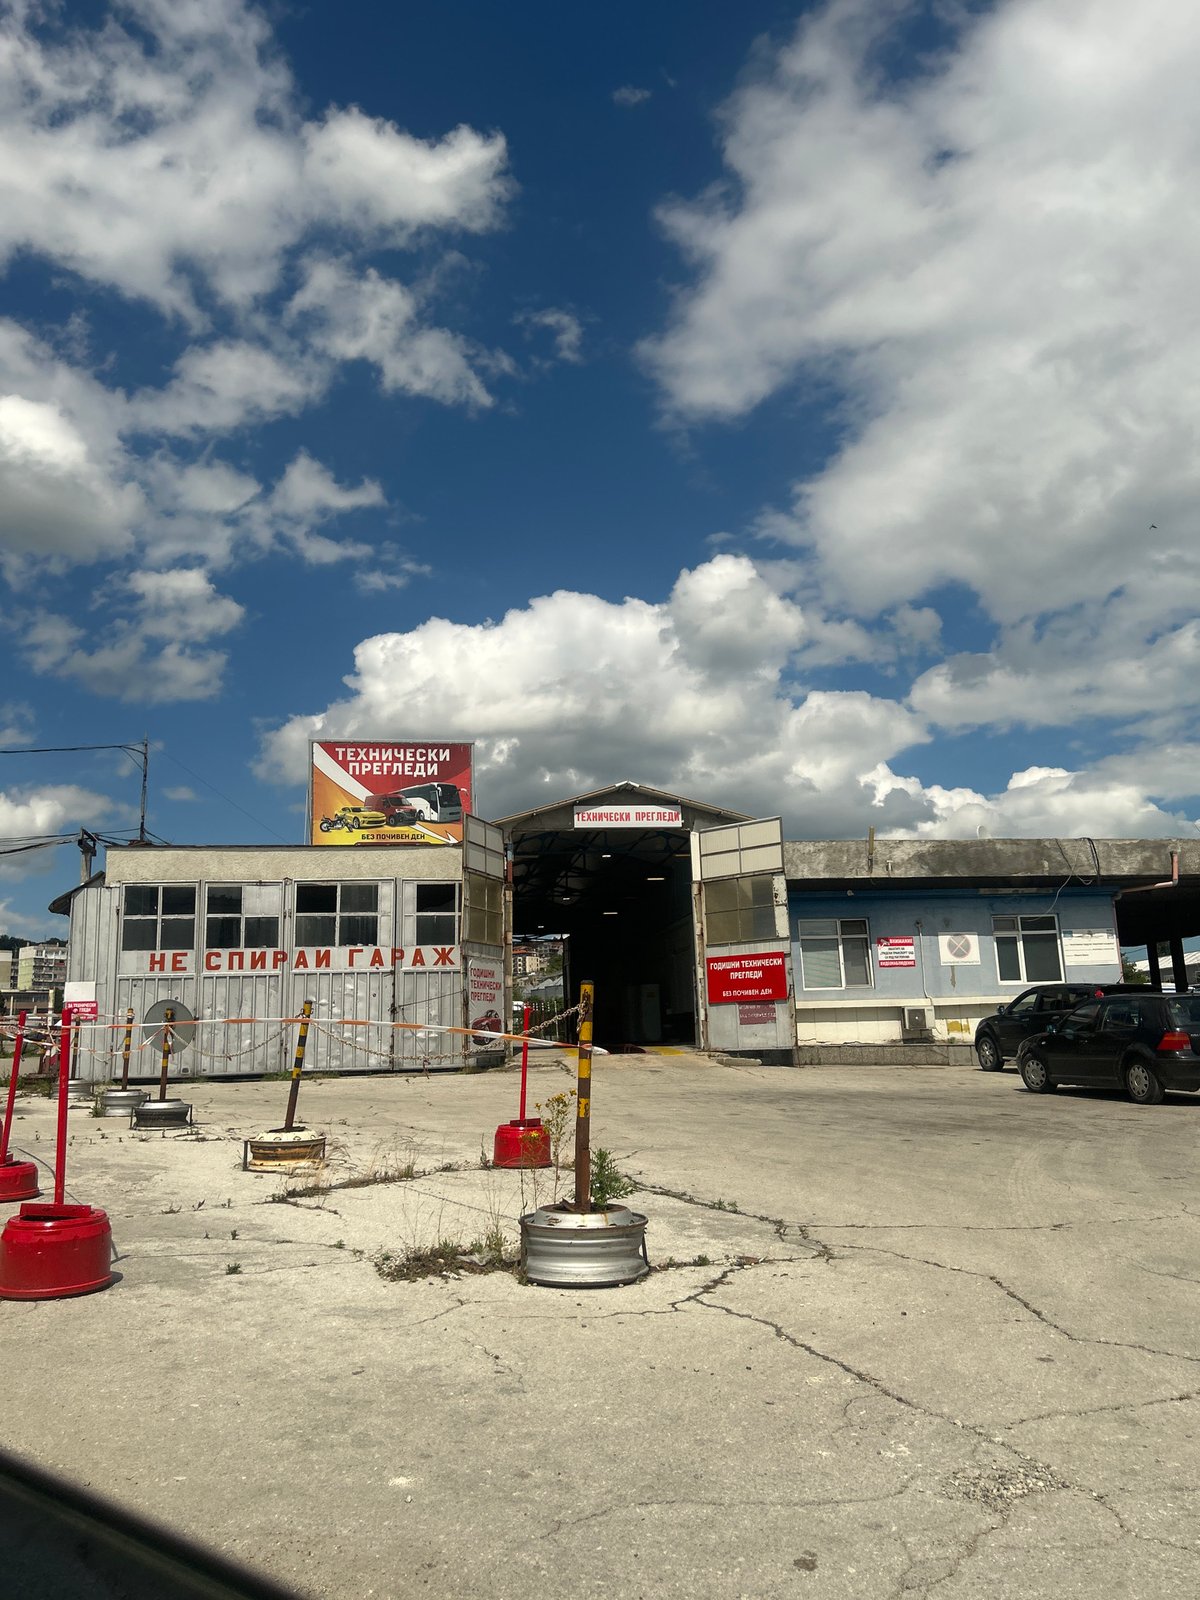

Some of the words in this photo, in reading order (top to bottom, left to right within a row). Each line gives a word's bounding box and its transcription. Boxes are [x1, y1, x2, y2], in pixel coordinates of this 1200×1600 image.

[335, 747, 450, 762] ТЕХНИЧЕСКИ
[348, 762, 438, 778] ПРЕГЛЕДИ
[576, 811, 631, 822] ТЕХНИЧЕСКИ
[635, 811, 680, 823] ПРЕГЛЕДИ
[361, 833, 375, 841] БЕЗ
[376, 833, 410, 841] ПОЧИВЕН
[411, 833, 425, 841] ДЕН
[149, 952, 188, 971] НЕ
[348, 947, 455, 967] ГАРАЖ
[710, 960, 740, 971] ГОДИШНИ
[741, 958, 783, 968] ТЕХНИЧЕСКИ
[470, 967, 495, 979] ГОДИШНИ
[730, 970, 763, 980] ПРЕГЛЕДИ
[470, 980, 502, 991] ТЕХНИЧЕСКИ
[470, 991, 496, 1003] ПРЕГЛЕДИ
